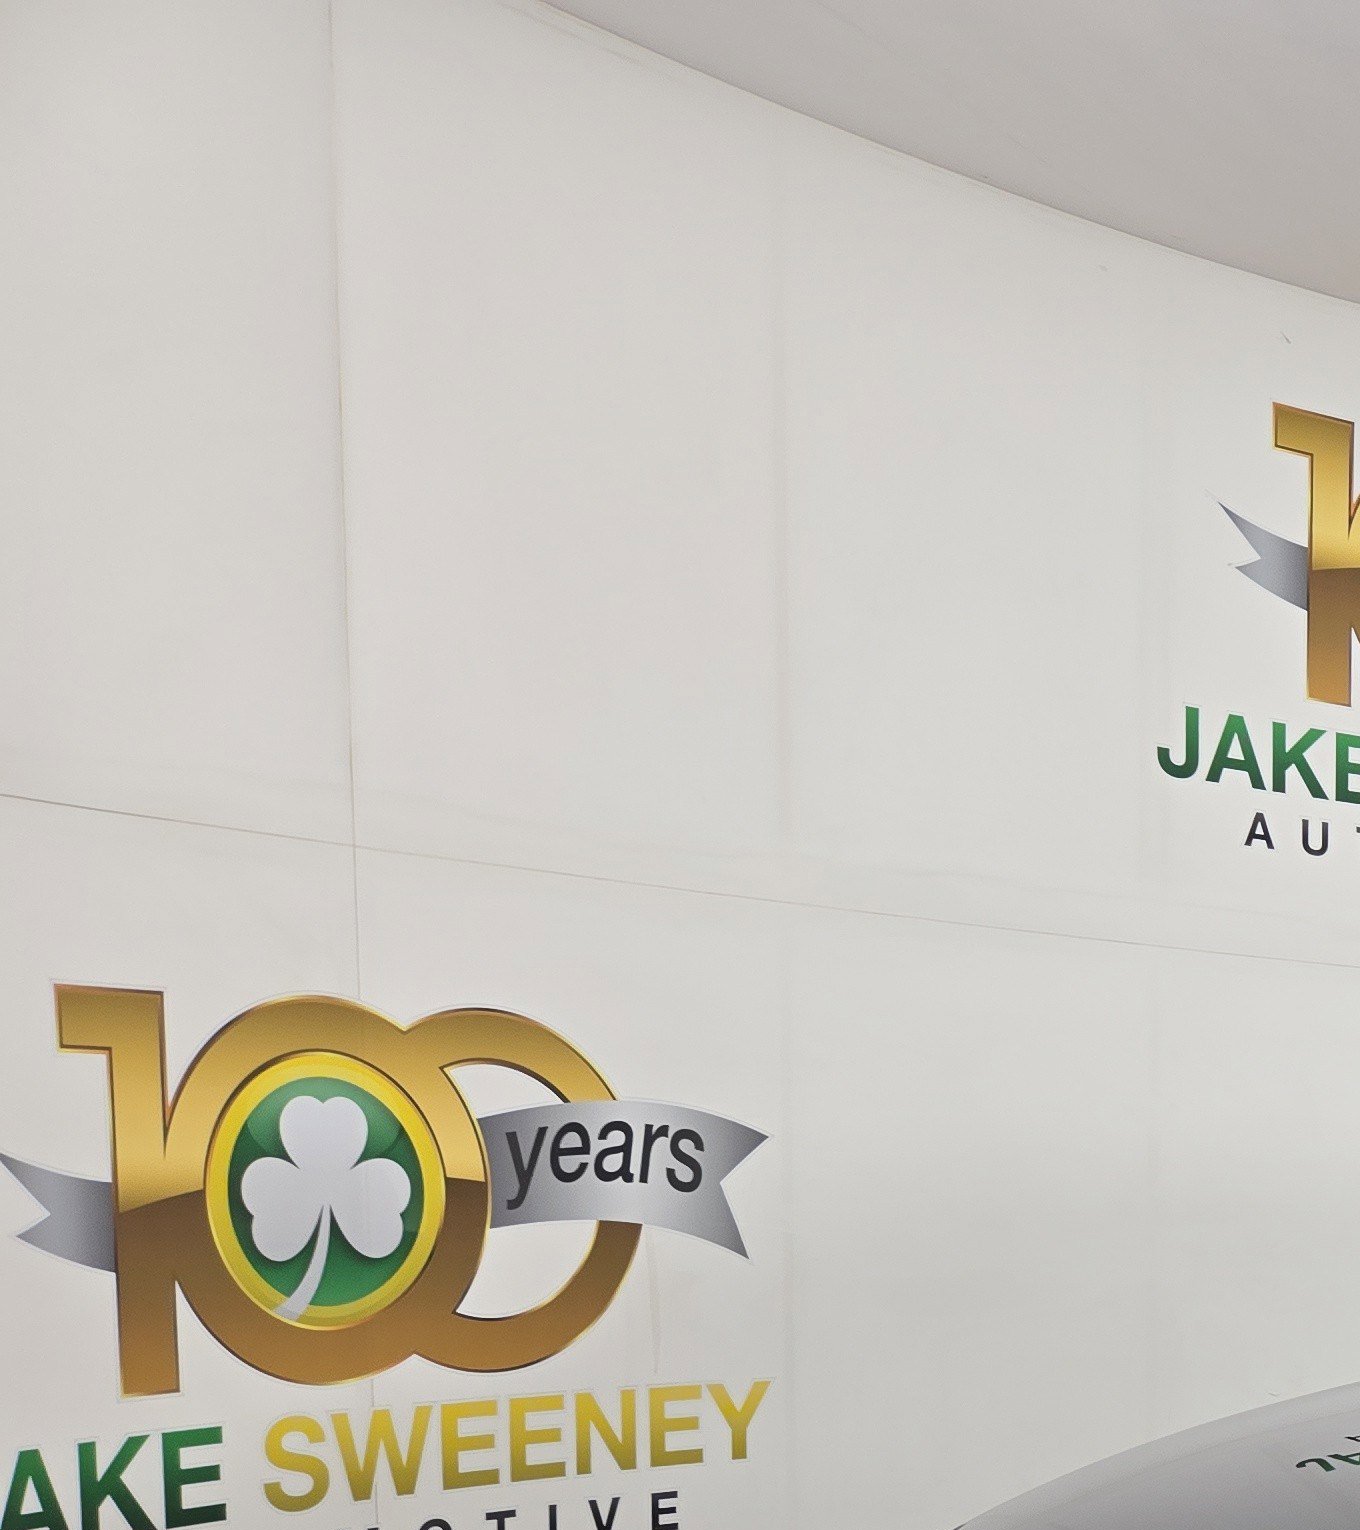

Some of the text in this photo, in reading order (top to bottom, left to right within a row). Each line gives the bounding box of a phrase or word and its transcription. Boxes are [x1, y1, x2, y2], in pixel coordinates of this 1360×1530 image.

[53, 982, 706, 1399] 100 years
[261, 1379, 773, 1514] SWEENEY
